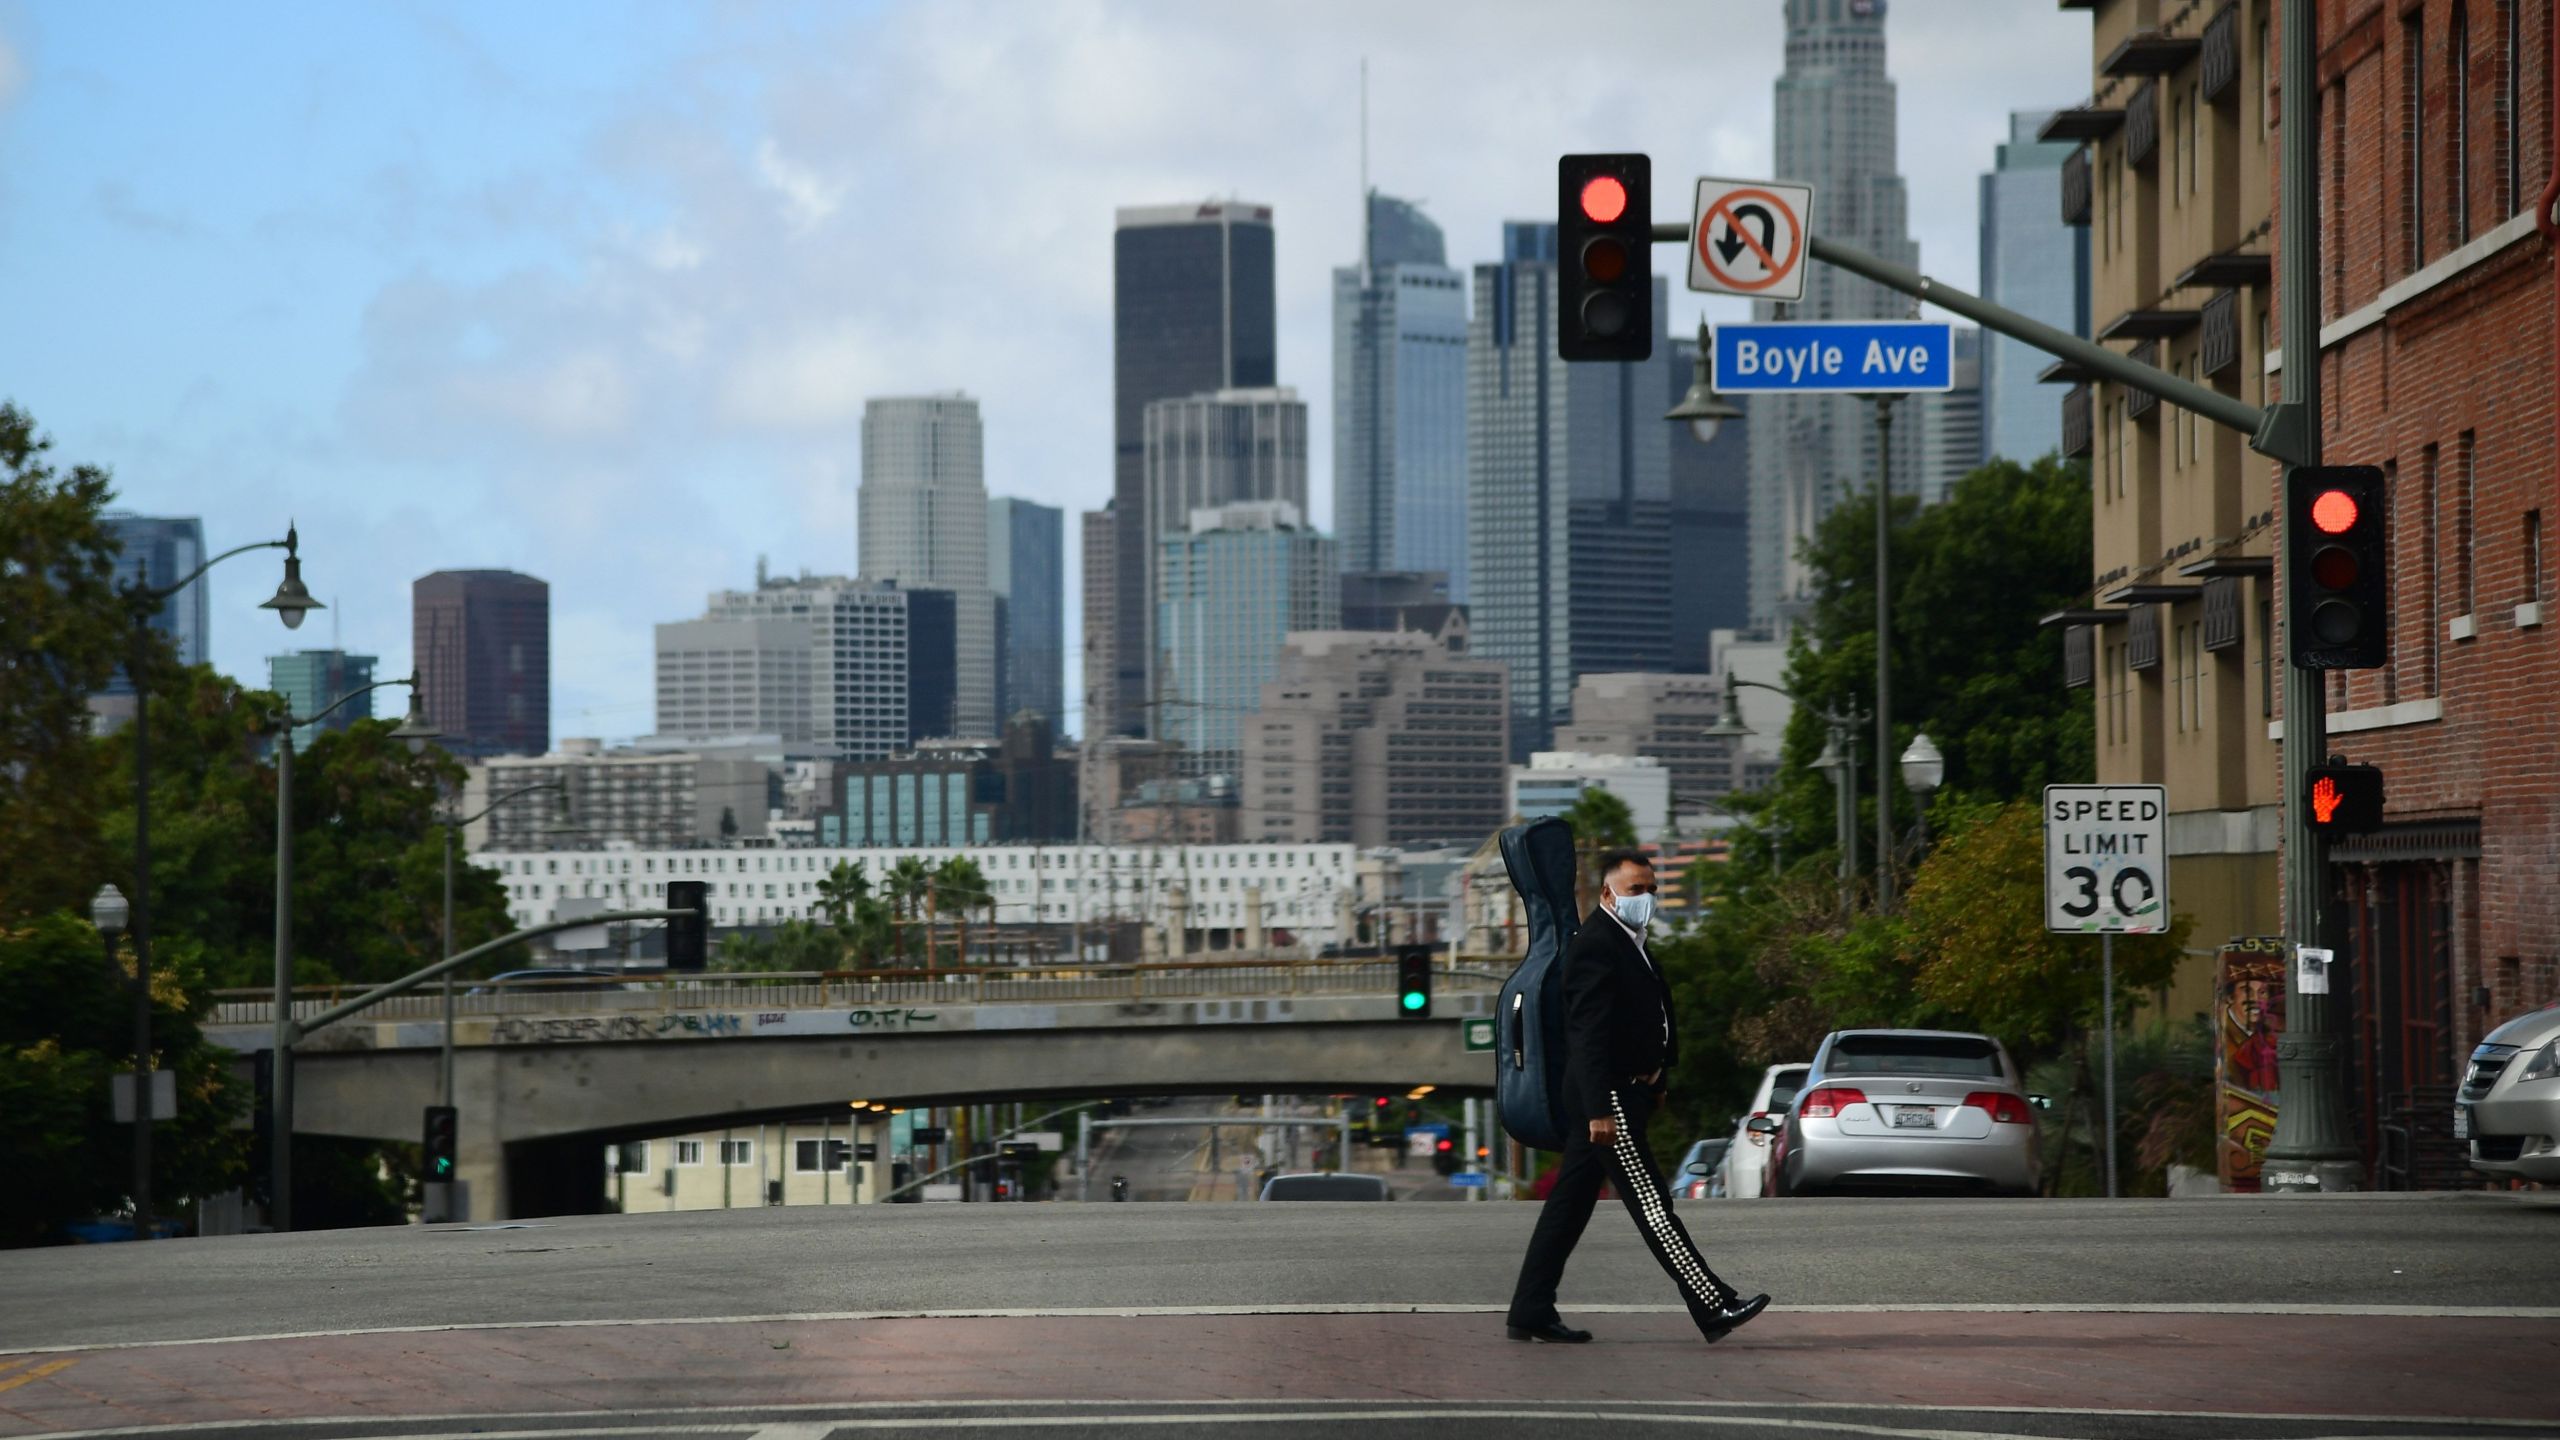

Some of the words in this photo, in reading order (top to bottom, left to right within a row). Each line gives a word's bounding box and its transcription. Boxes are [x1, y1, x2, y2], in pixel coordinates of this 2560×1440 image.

[1736, 340, 1843, 384] Boyle
[1861, 338, 1929, 375] Ave
[2054, 800, 2158, 821] SPEED
[2064, 833, 2148, 854] LIMIT
[2060, 866, 2154, 918] 30
